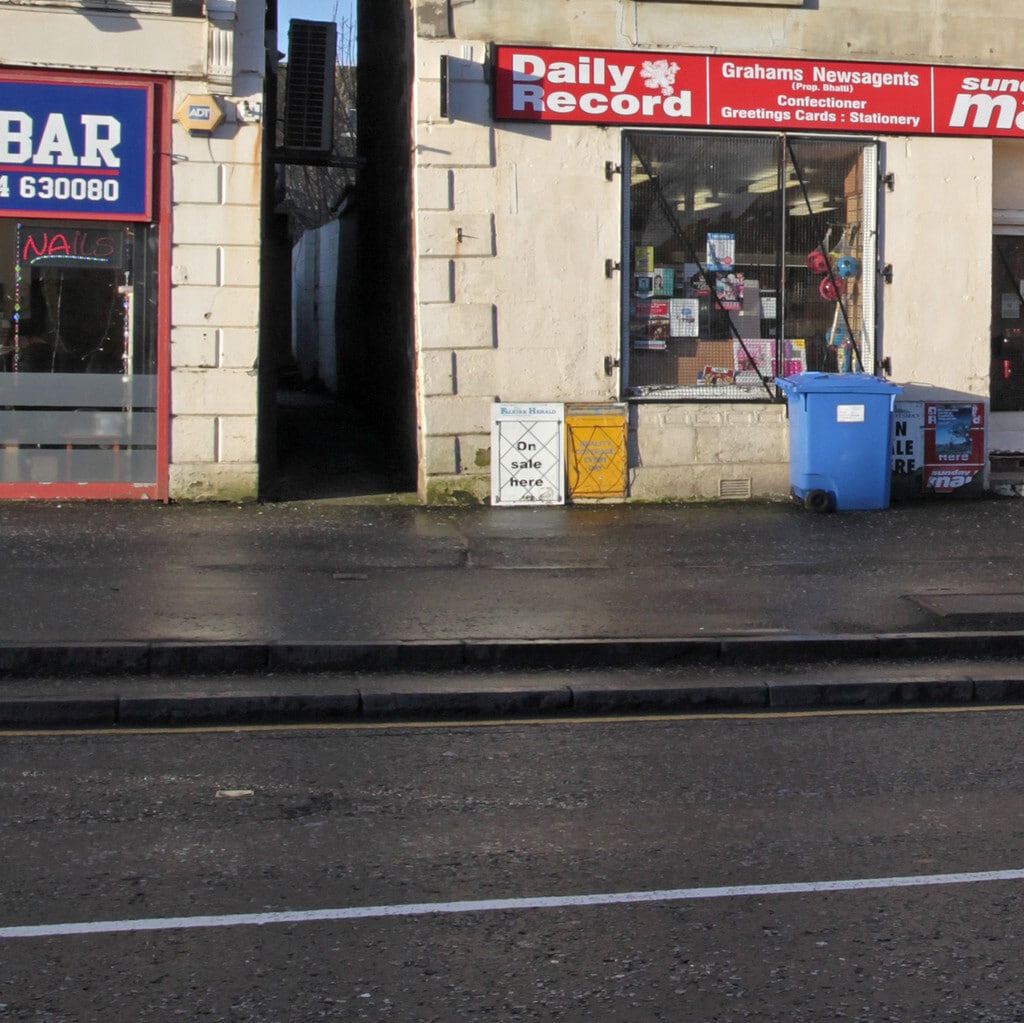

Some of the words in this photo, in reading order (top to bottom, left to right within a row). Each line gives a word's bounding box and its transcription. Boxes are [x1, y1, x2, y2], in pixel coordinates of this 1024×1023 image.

[512, 53, 635, 93] Daily
[722, 62, 803, 81] Grahams
[813, 66, 919, 88] Newsagents
[792, 82, 820, 93] (Prop.
[823, 83, 853, 94] Bhatti)
[512, 83, 692, 118] Record
[777, 94, 867, 109] Confectioner
[188, 106, 210, 118] ADT
[721, 106, 791, 122] Greetings
[795, 109, 836, 122] Cards
[850, 112, 920, 127] Stationery
[0, 110, 121, 167] BAR
[20, 176, 119, 201] 630080
[23, 231, 114, 261] NAILS
[517, 441, 536, 451] On
[511, 459, 542, 469] sale
[510, 477, 544, 487] here
